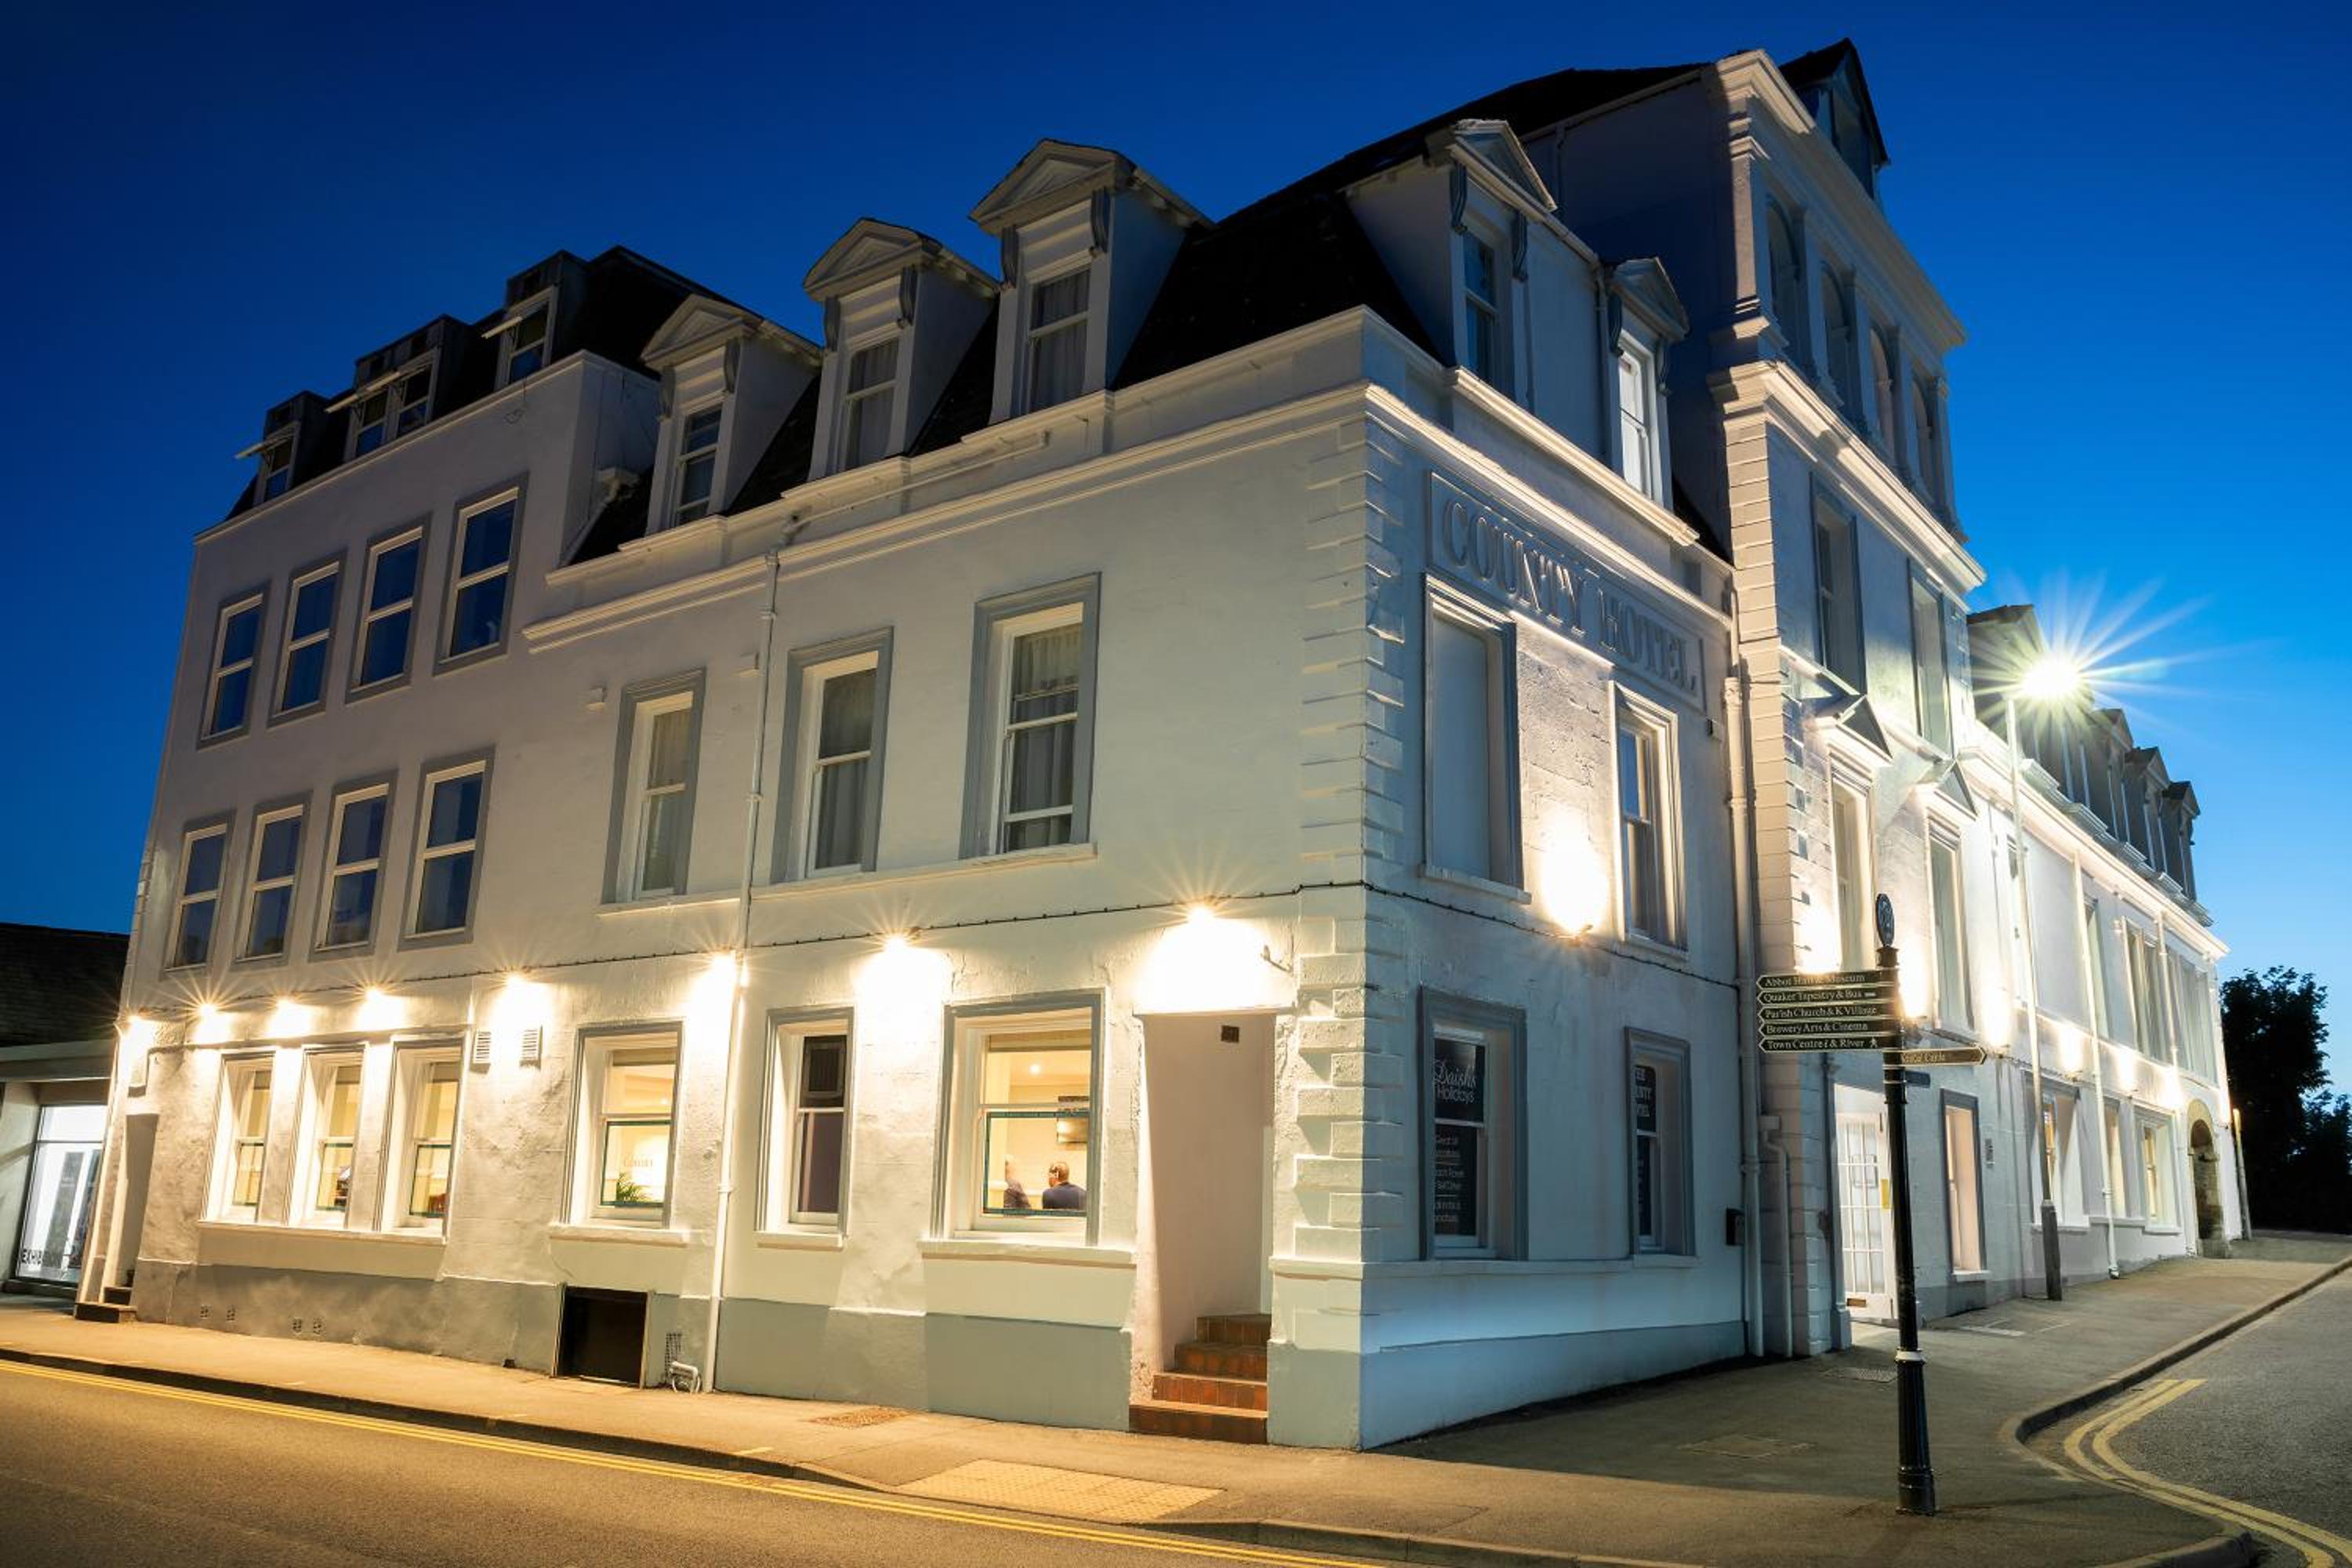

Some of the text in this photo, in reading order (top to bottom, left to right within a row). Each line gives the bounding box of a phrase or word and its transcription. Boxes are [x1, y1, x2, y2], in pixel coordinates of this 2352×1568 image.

[1443, 499, 1697, 694] COUNTY HOTEL
[1766, 978, 1791, 986] Abbot
[1764, 993, 1795, 1003] Quaker
[1799, 991, 1835, 1002] Tapestry
[1835, 990, 1845, 999] &
[1766, 1010, 1794, 1018] Parish
[1794, 1007, 1826, 1017] Church
[1803, 1023, 1823, 1033] Arts
[1824, 1023, 1832, 1032] &
[1832, 1022, 1868, 1031] Cinema
[1768, 1040, 1792, 1050] Town
[1792, 1039, 1824, 1049] Centre
[1829, 1039, 1838, 1047] &
[1840, 1038, 1865, 1047] River
